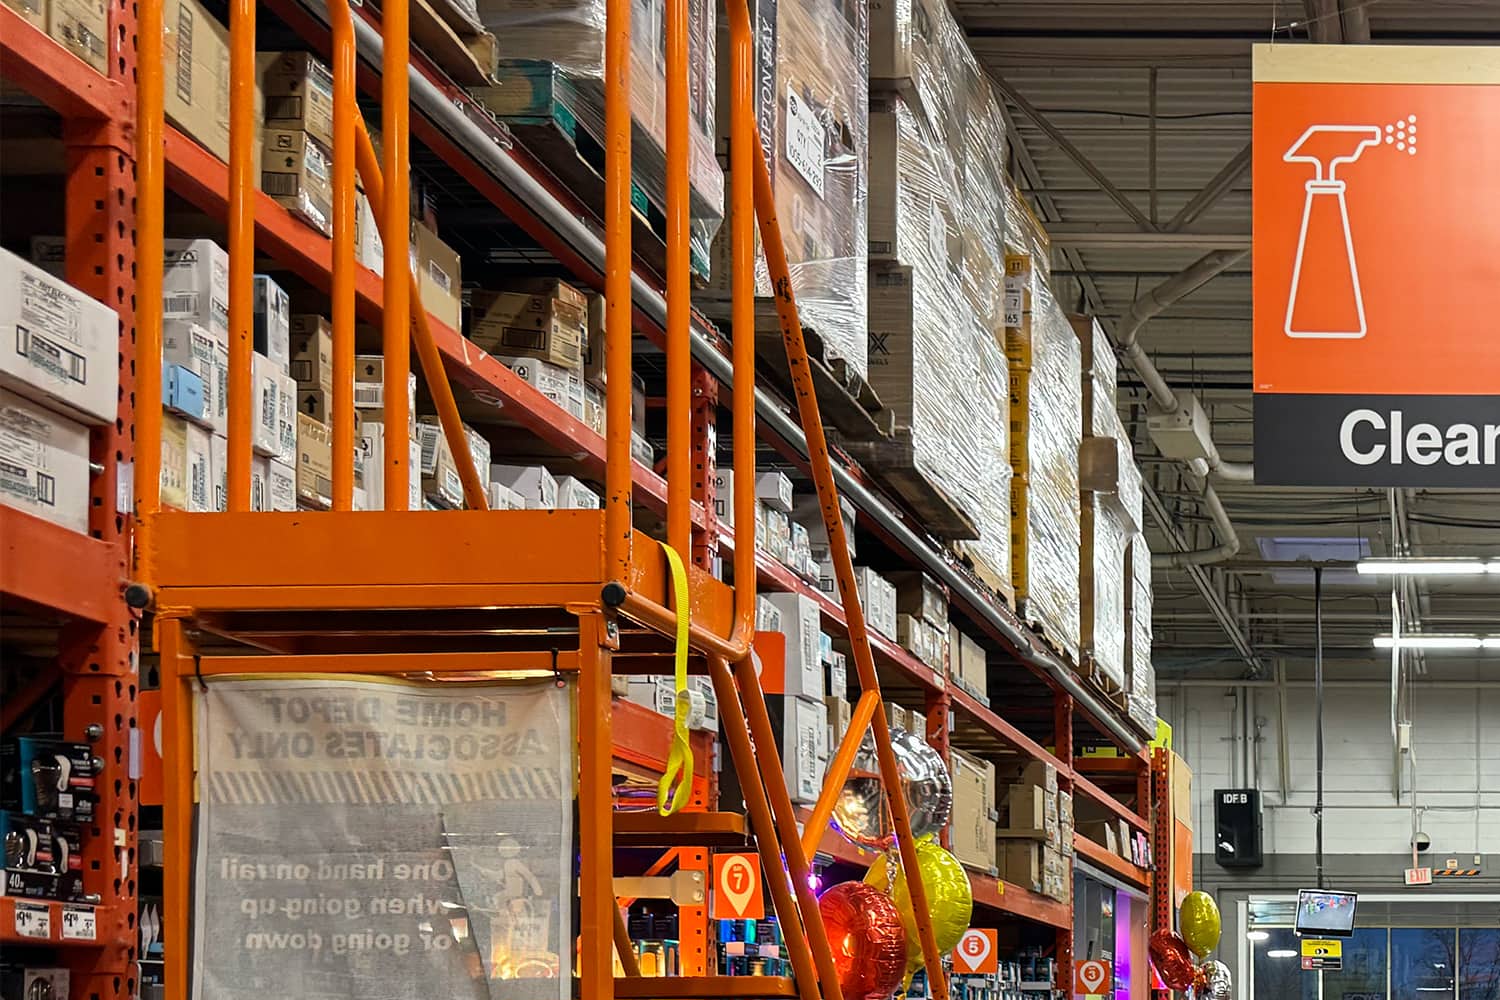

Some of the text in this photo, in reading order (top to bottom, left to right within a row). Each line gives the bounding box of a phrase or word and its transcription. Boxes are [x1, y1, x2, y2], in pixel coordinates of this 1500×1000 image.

[733, 873, 743, 890] 7
[1409, 868, 1428, 883] EXIT
[968, 942, 979, 954] 5
[1088, 969, 1097, 980] 3
